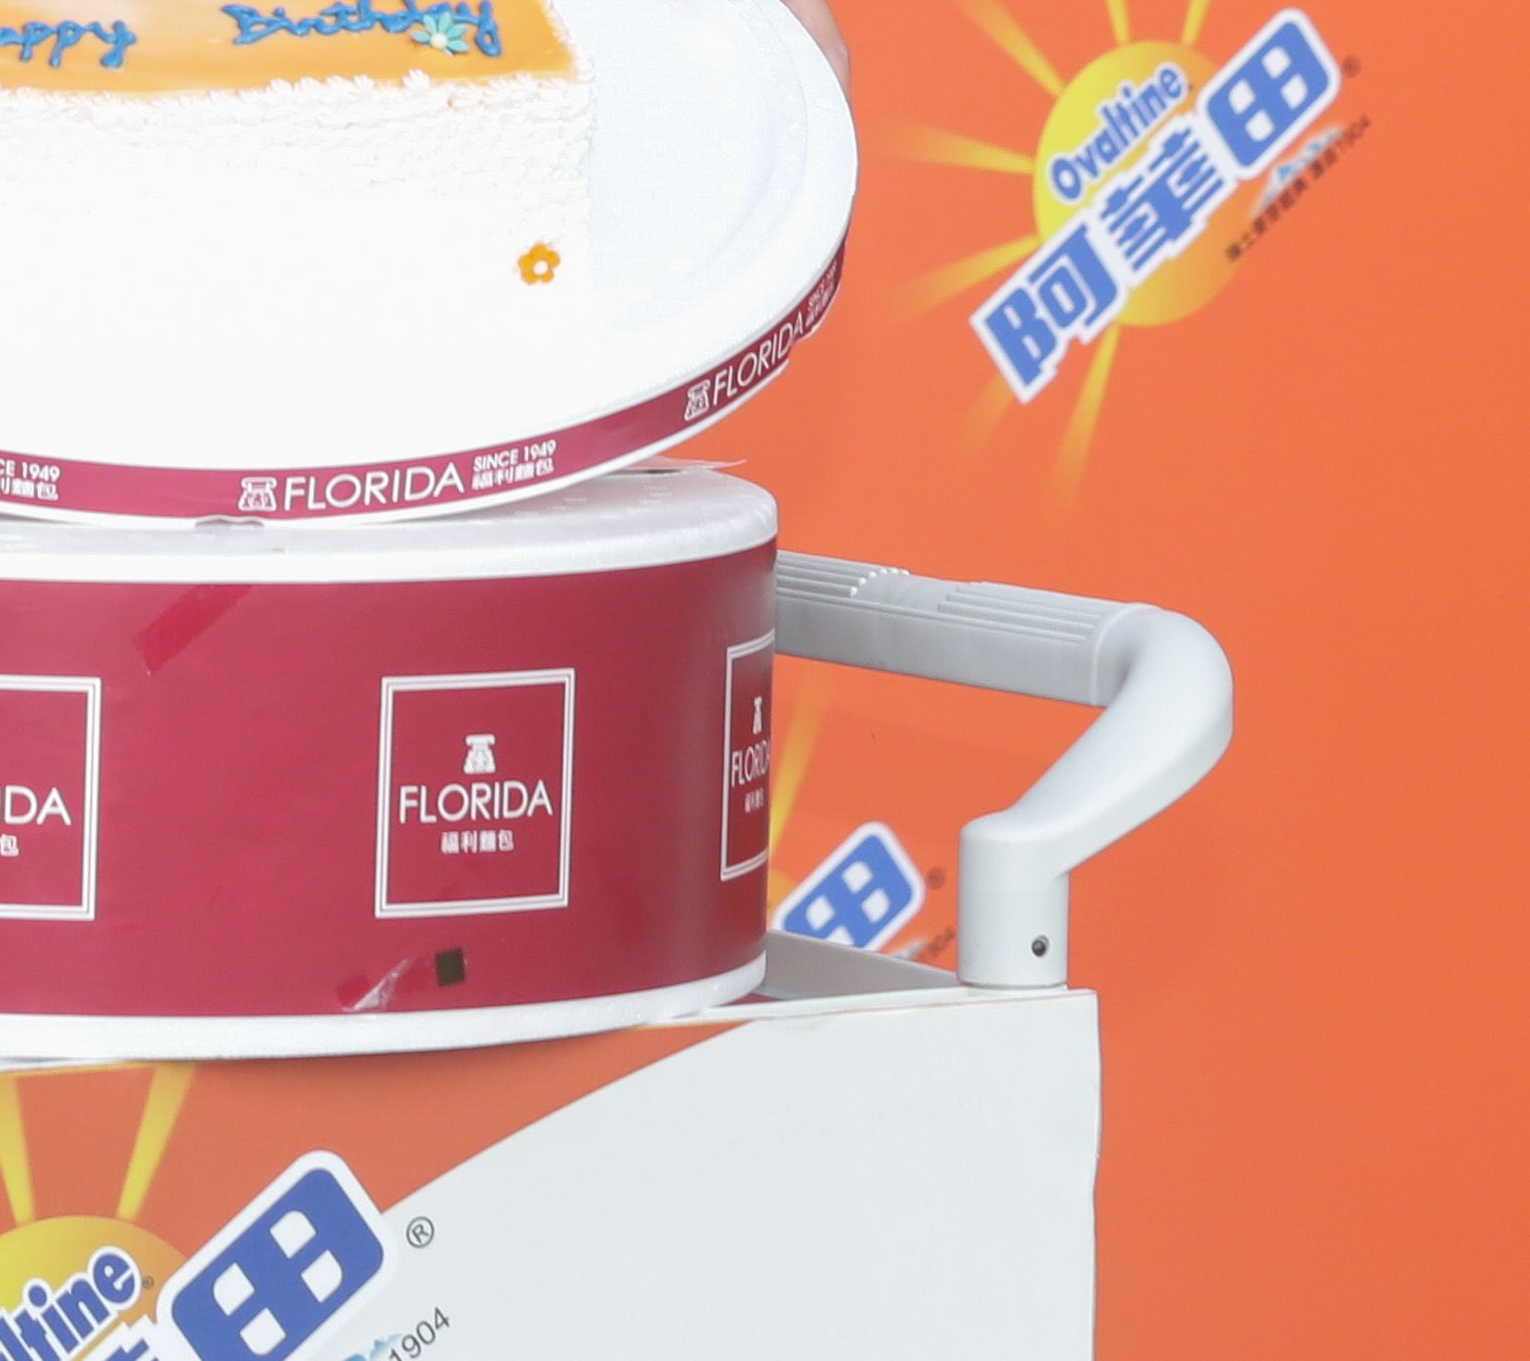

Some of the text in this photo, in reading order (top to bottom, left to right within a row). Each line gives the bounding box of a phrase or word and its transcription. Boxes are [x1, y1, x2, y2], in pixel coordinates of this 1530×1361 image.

[1052, 68, 1182, 200] Ovaltine
[984, 21, 1329, 386] 阿華田
[713, 311, 803, 405] FLORIDA
[22, 462, 60, 482] 1949
[473, 439, 557, 471] SINCE 1949
[284, 463, 465, 511] FLORIDA
[731, 738, 770, 787] FLORID
[399, 779, 553, 824] FLORIDA
